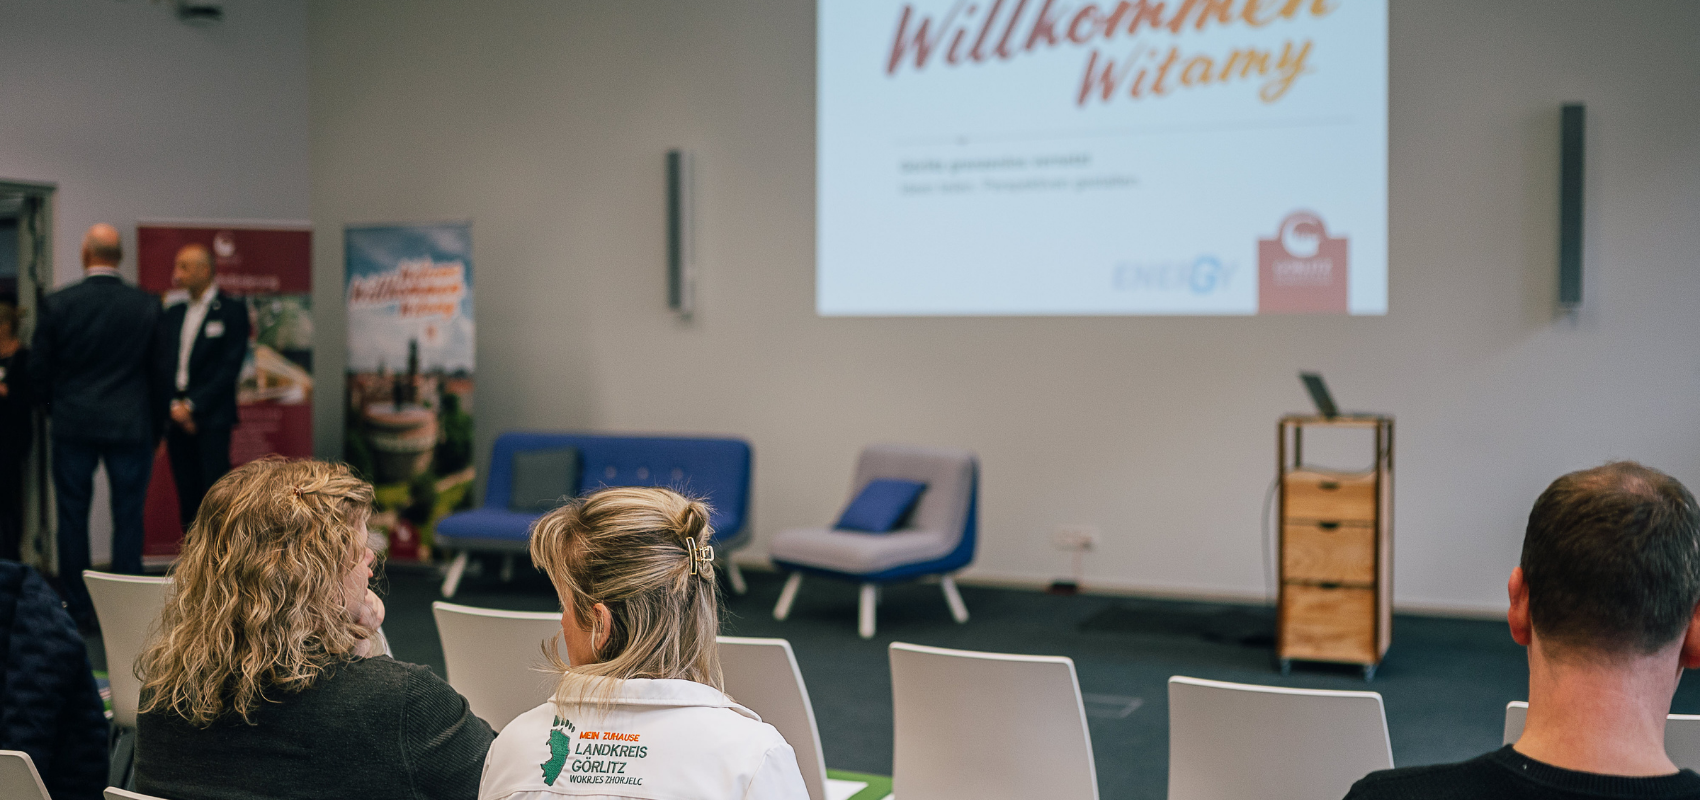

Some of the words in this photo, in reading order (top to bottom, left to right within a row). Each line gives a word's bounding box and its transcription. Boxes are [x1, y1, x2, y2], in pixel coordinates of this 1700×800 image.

[1074, 40, 1315, 107] Witamy
[579, 731, 600, 740] MEIN
[603, 731, 640, 742] ZUHAUSE
[575, 743, 648, 758] LANDKREIS
[571, 757, 627, 774] GÖRLITZ
[569, 774, 604, 784] WOKRJES
[605, 775, 643, 786] ZHORJELC
